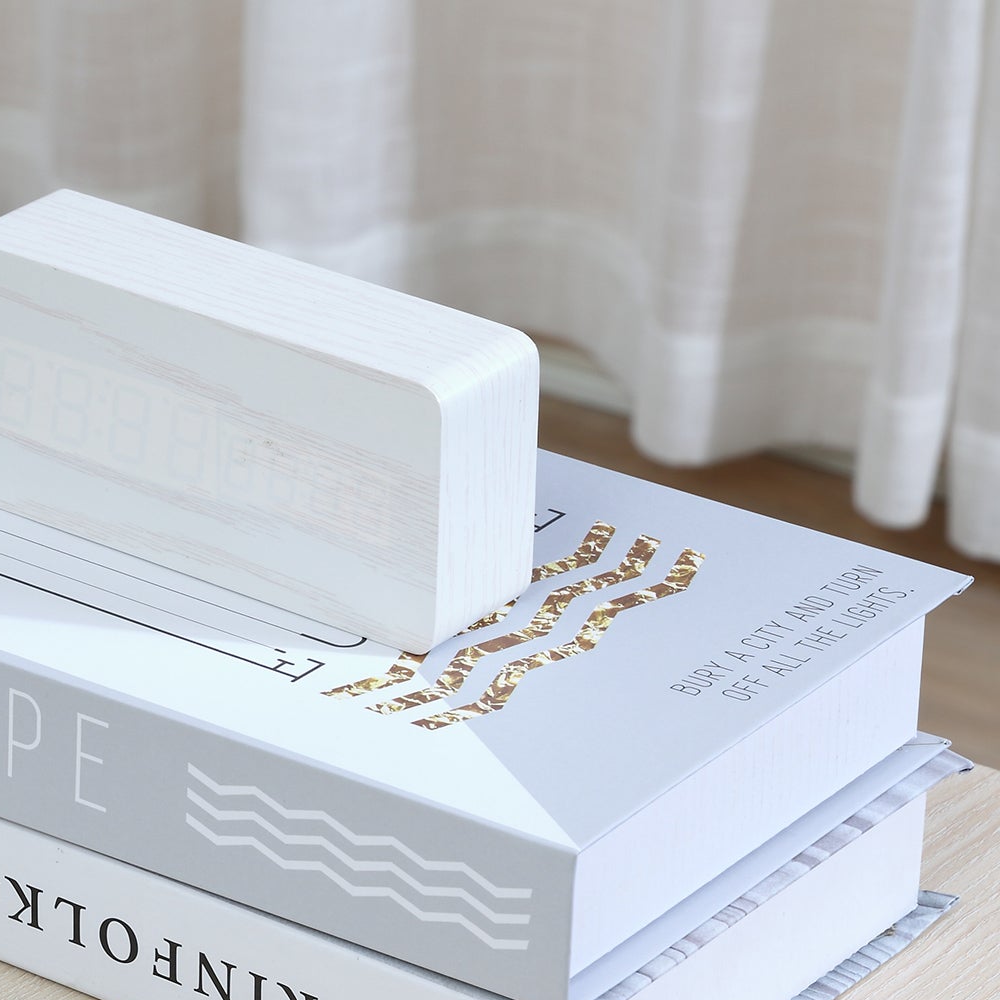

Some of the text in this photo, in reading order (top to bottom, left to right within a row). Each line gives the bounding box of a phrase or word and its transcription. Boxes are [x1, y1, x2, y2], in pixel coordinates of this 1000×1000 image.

[670, 565, 883, 696] BURY A CITY AND TURN
[722, 587, 915, 701] OFF ALL THE LIGHTS.
